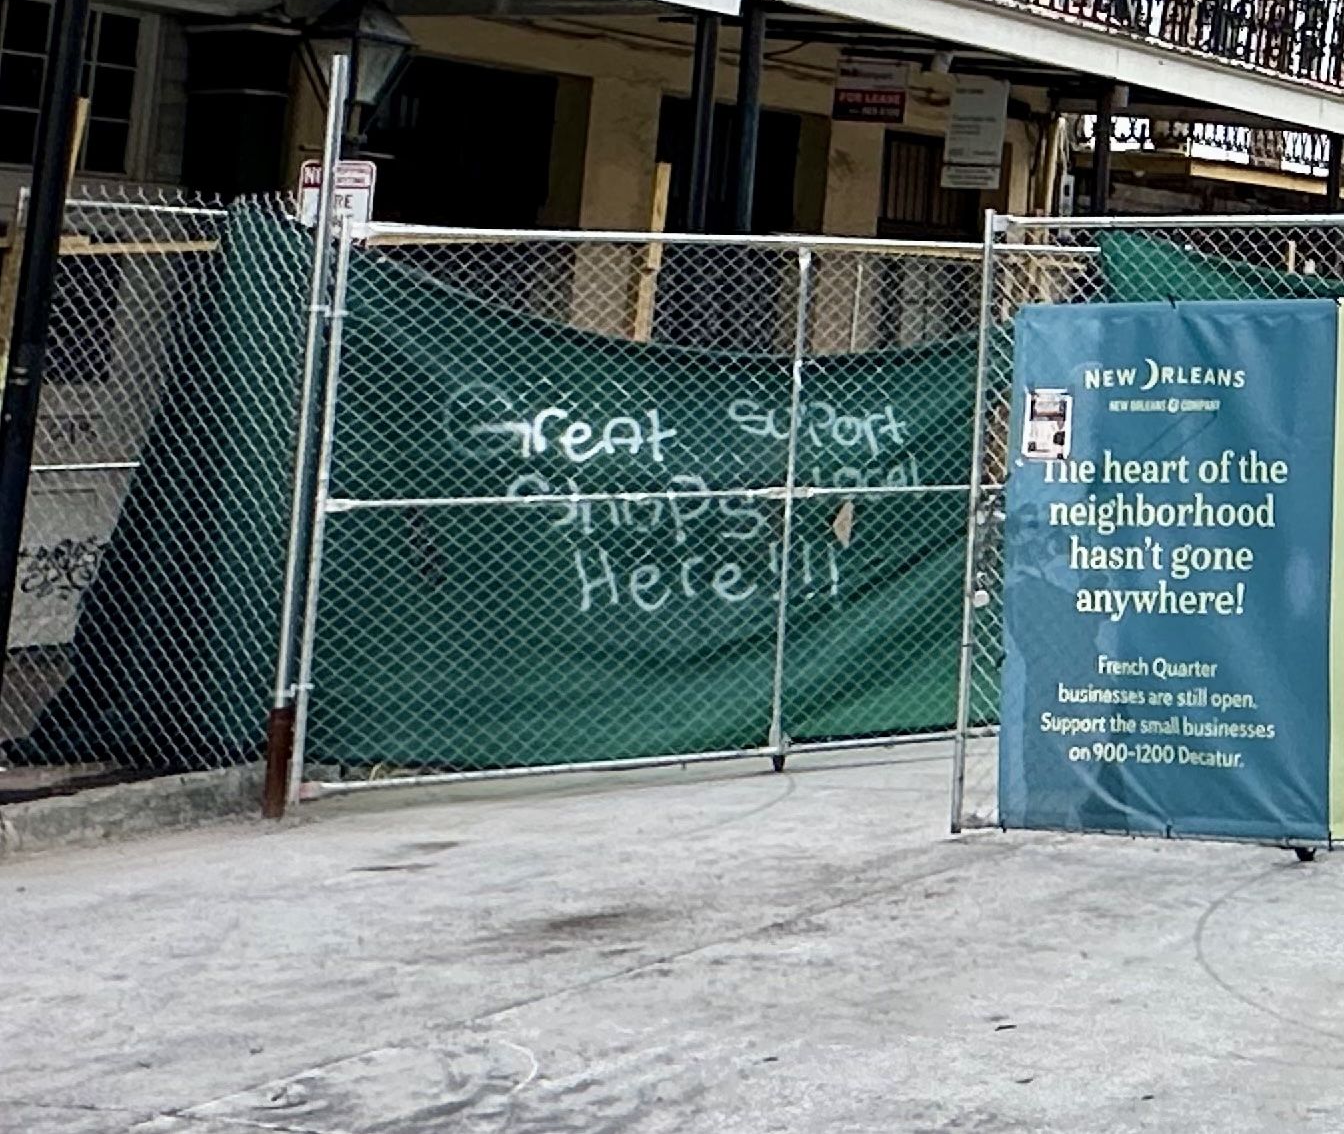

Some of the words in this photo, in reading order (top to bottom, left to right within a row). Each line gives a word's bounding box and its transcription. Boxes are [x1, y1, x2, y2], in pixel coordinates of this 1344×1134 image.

[839, 92, 863, 103] FOR
[864, 93, 901, 105] LEASE
[1084, 367, 1137, 390] NEW
[1102, 448, 1190, 484] heart
[1199, 449, 1235, 484] of
[1238, 448, 1289, 484] the
[1049, 492, 1276, 535] neighborhood
[1069, 535, 1164, 570] hasn't
[1170, 545, 1254, 580] gone
[1075, 579, 1245, 622] anywhere!
[1098, 654, 1149, 677] French
[1152, 656, 1218, 680] Quarter
[1058, 682, 1146, 704] businesses
[1148, 691, 1173, 707] are
[1177, 687, 1208, 709] still
[1211, 692, 1259, 713] open.
[1040, 712, 1106, 736] Support
[1110, 714, 1137, 734] the
[1140, 716, 1181, 735] small
[1183, 717, 1276, 739] businesses
[1069, 745, 1091, 762] on
[1092, 742, 1176, 765] 900-1200
[1178, 746, 1246, 768] Decatur.
